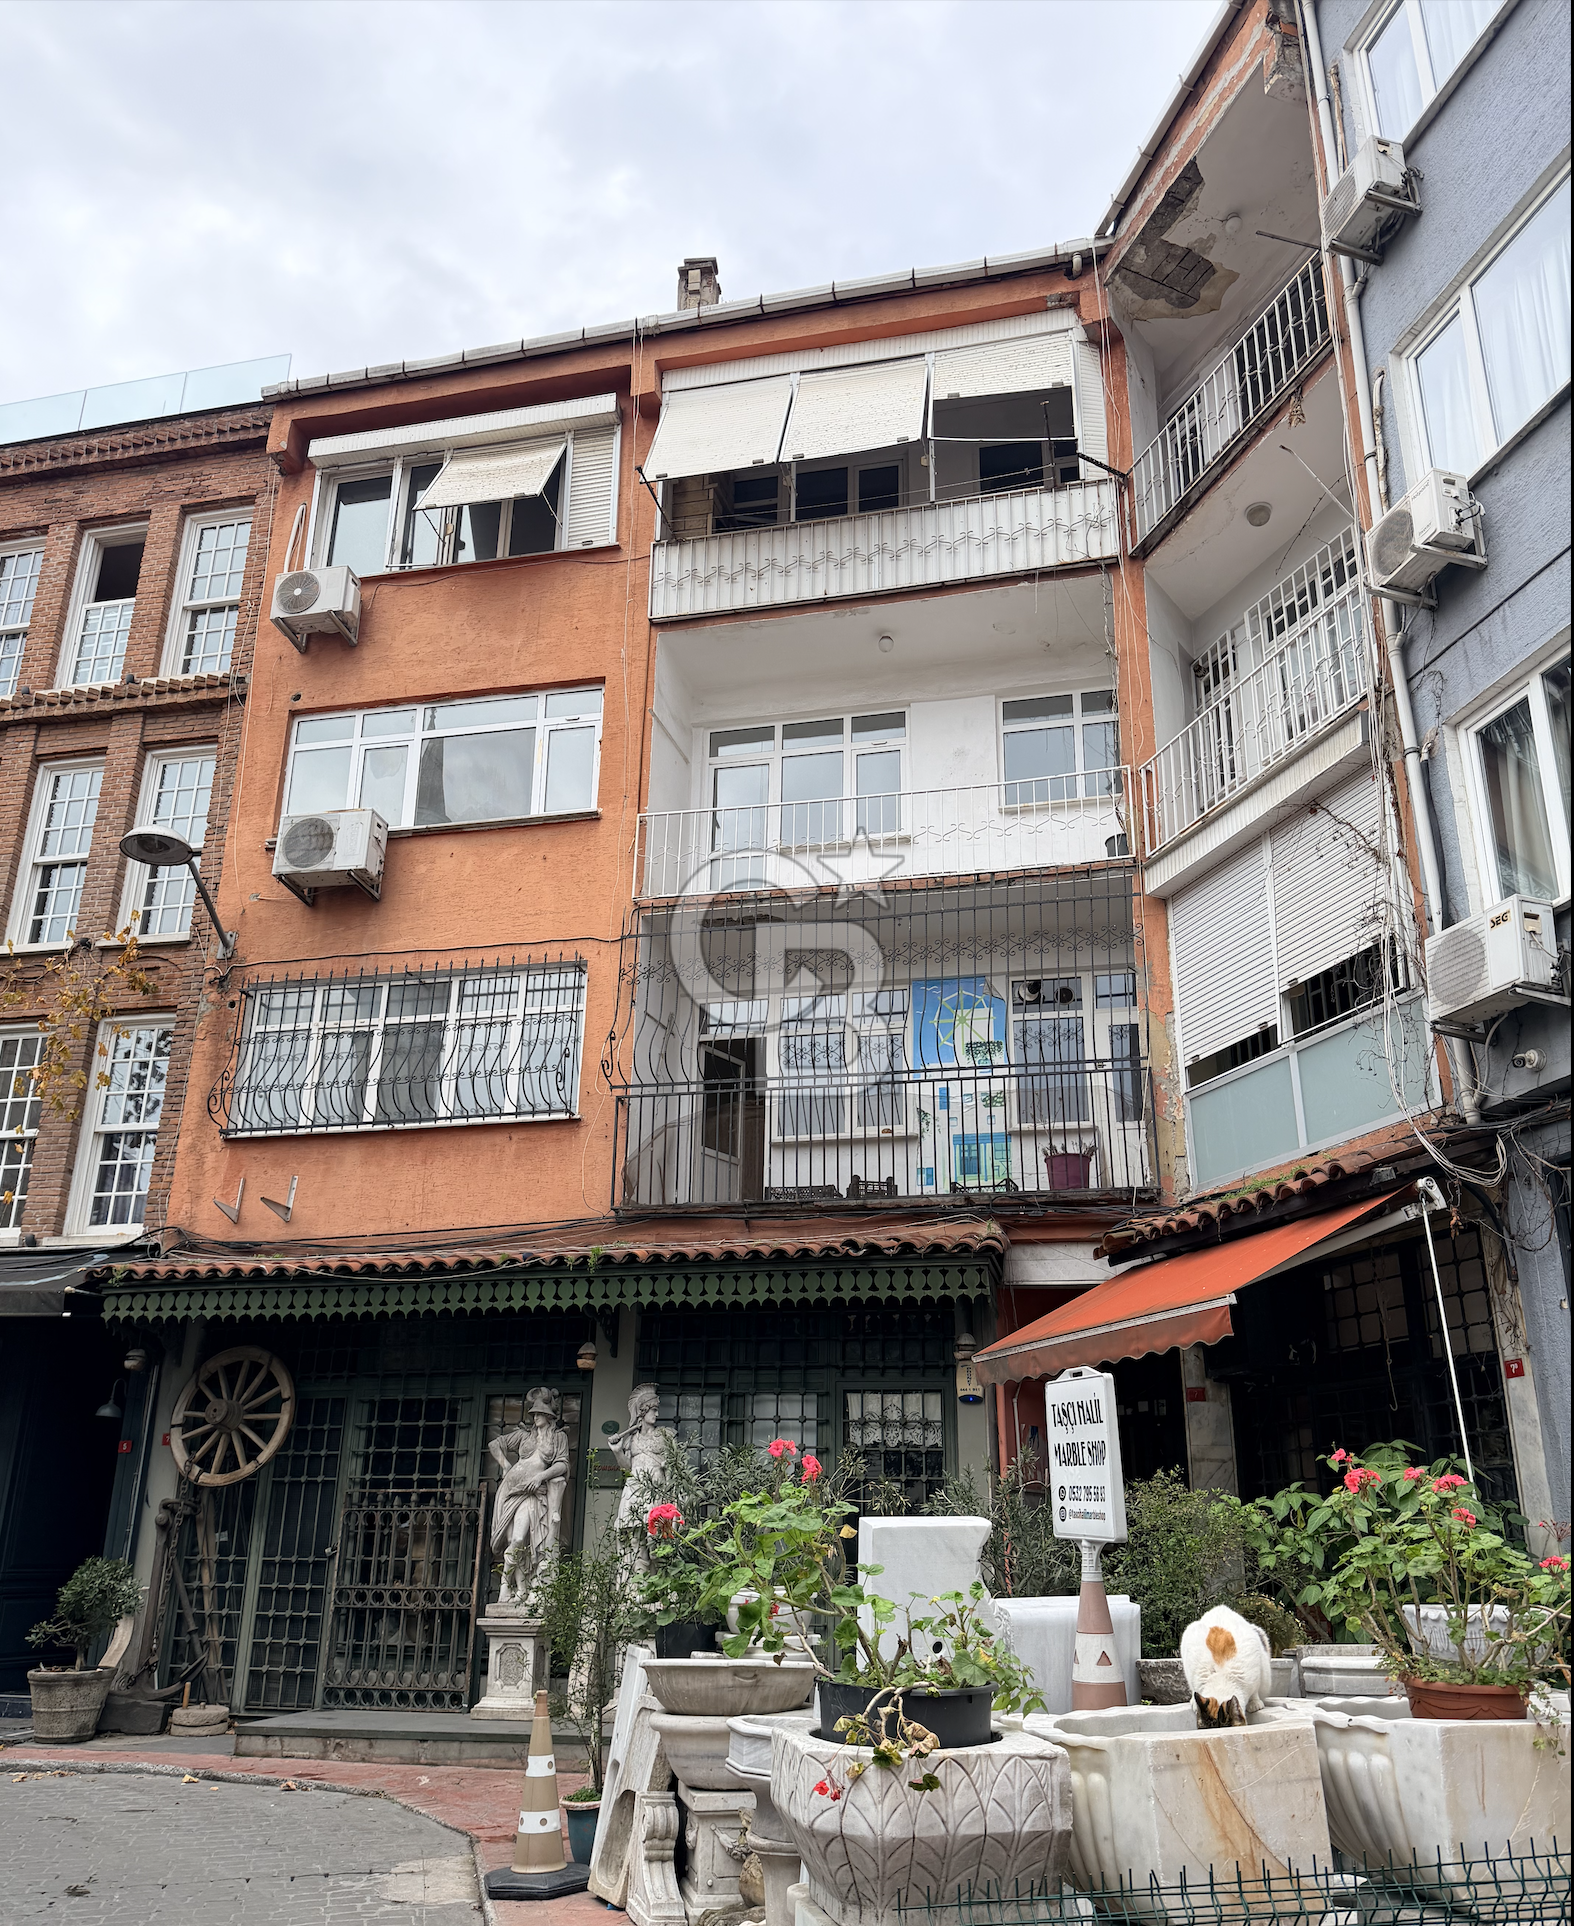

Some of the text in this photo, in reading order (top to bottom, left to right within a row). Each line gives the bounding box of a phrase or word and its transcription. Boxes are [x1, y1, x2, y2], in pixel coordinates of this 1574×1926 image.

[1490, 911, 1509, 929] SEG
[1054, 1440, 1106, 1467] MARBLE SHOP
[1069, 1485, 1082, 1501] 0532
[1083, 1485, 1093, 1501] 795
